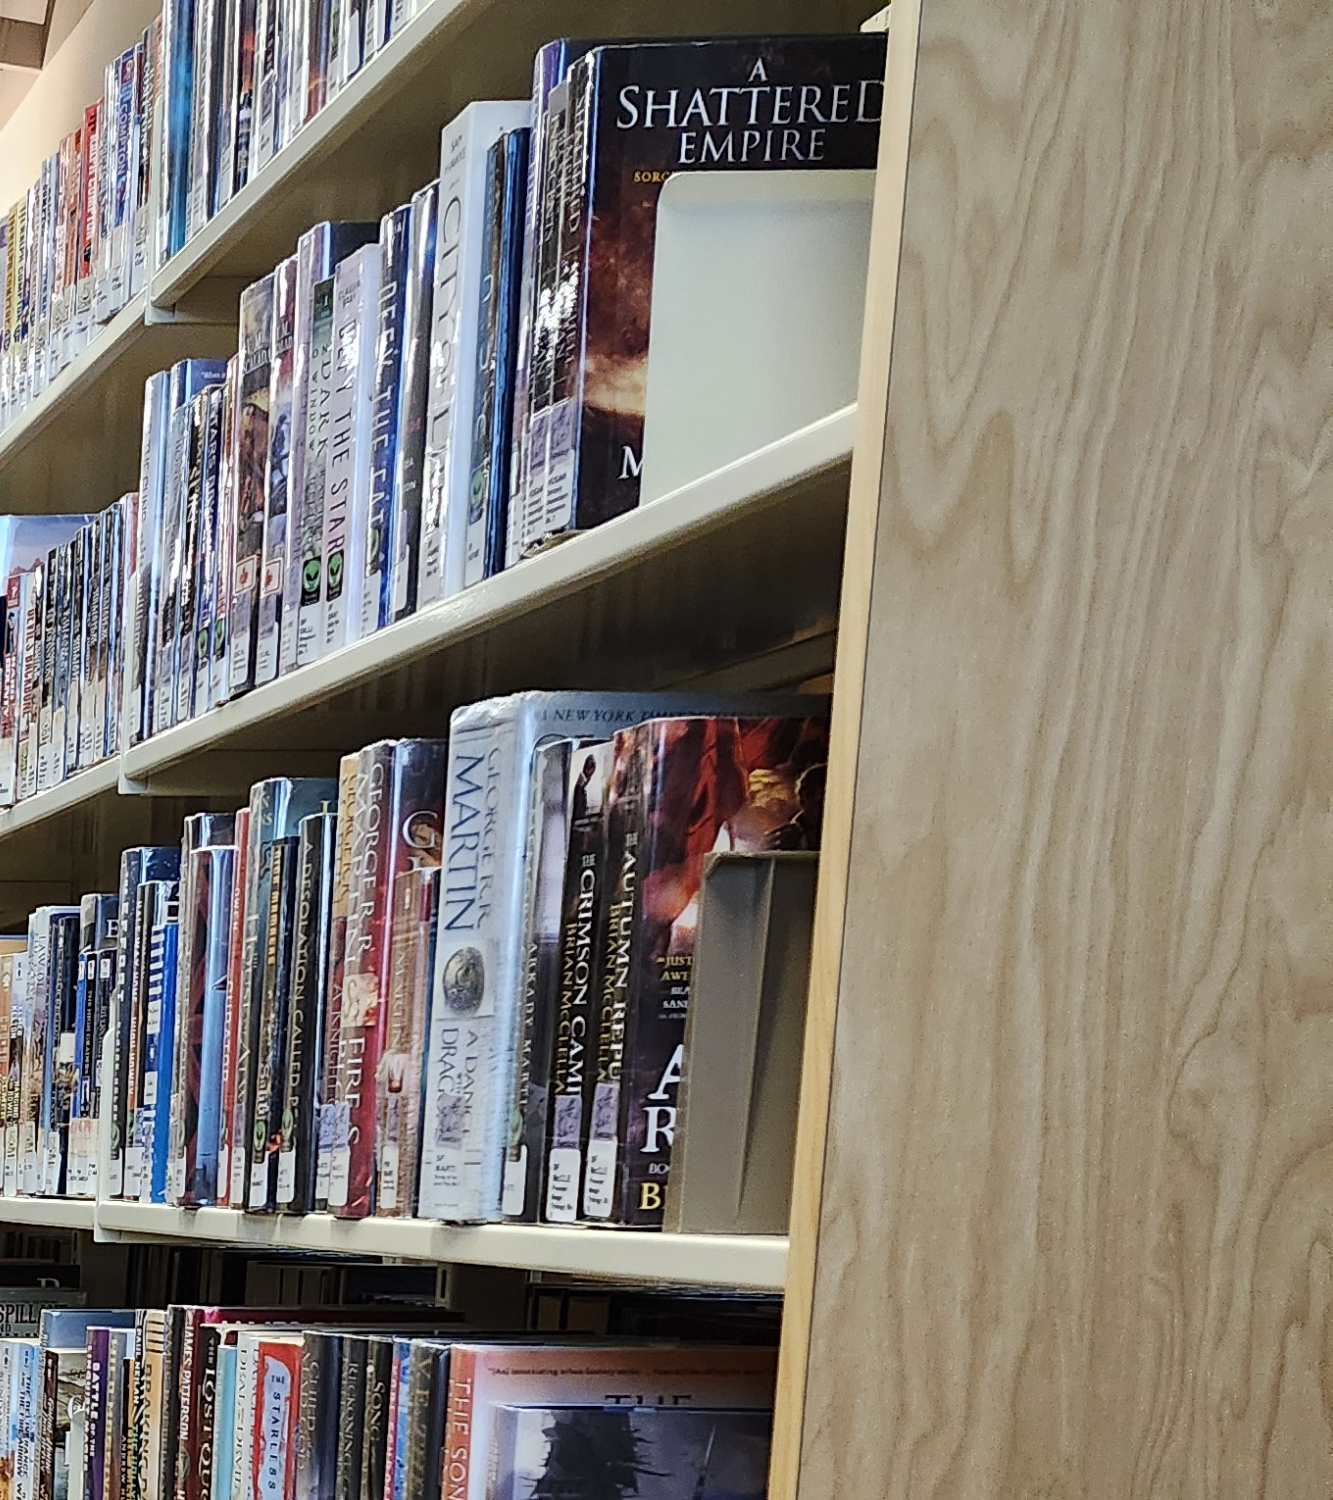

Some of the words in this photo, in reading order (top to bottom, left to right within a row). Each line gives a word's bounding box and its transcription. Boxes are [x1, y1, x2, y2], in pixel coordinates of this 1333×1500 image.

[747, 57, 767, 82] A
[616, 79, 885, 131] SHATTERED
[677, 127, 827, 165] EMPIRE
[333, 408, 353, 468] THE
[327, 480, 348, 552] STAR
[554, 709, 594, 722] NEW
[594, 709, 634, 722] YORK
[362, 762, 384, 890] GEORGE
[444, 755, 486, 931] MARTIN
[293, 858, 317, 999] DESOLATION
[571, 868, 597, 1005] CRIMSON
[604, 904, 622, 967] BRIAN
[614, 850, 639, 988] AUTUMN
[562, 923, 578, 985] BRIAN
[289, 1010, 304, 1087] CALLED
[608, 1001, 628, 1081] REPU
[134, 1328, 143, 1358] PAUL
[183, 1324, 195, 1370] JAMES
[90, 1362, 101, 1417] BATTLE
[133, 1361, 141, 1408] NEILAN
[180, 1373, 191, 1441] PATTERSON
[202, 1368, 216, 1439] LOST
[370, 1381, 386, 1441] SONG
[453, 1378, 471, 1435] THE
[268, 1391, 282, 1488] STARLESS
